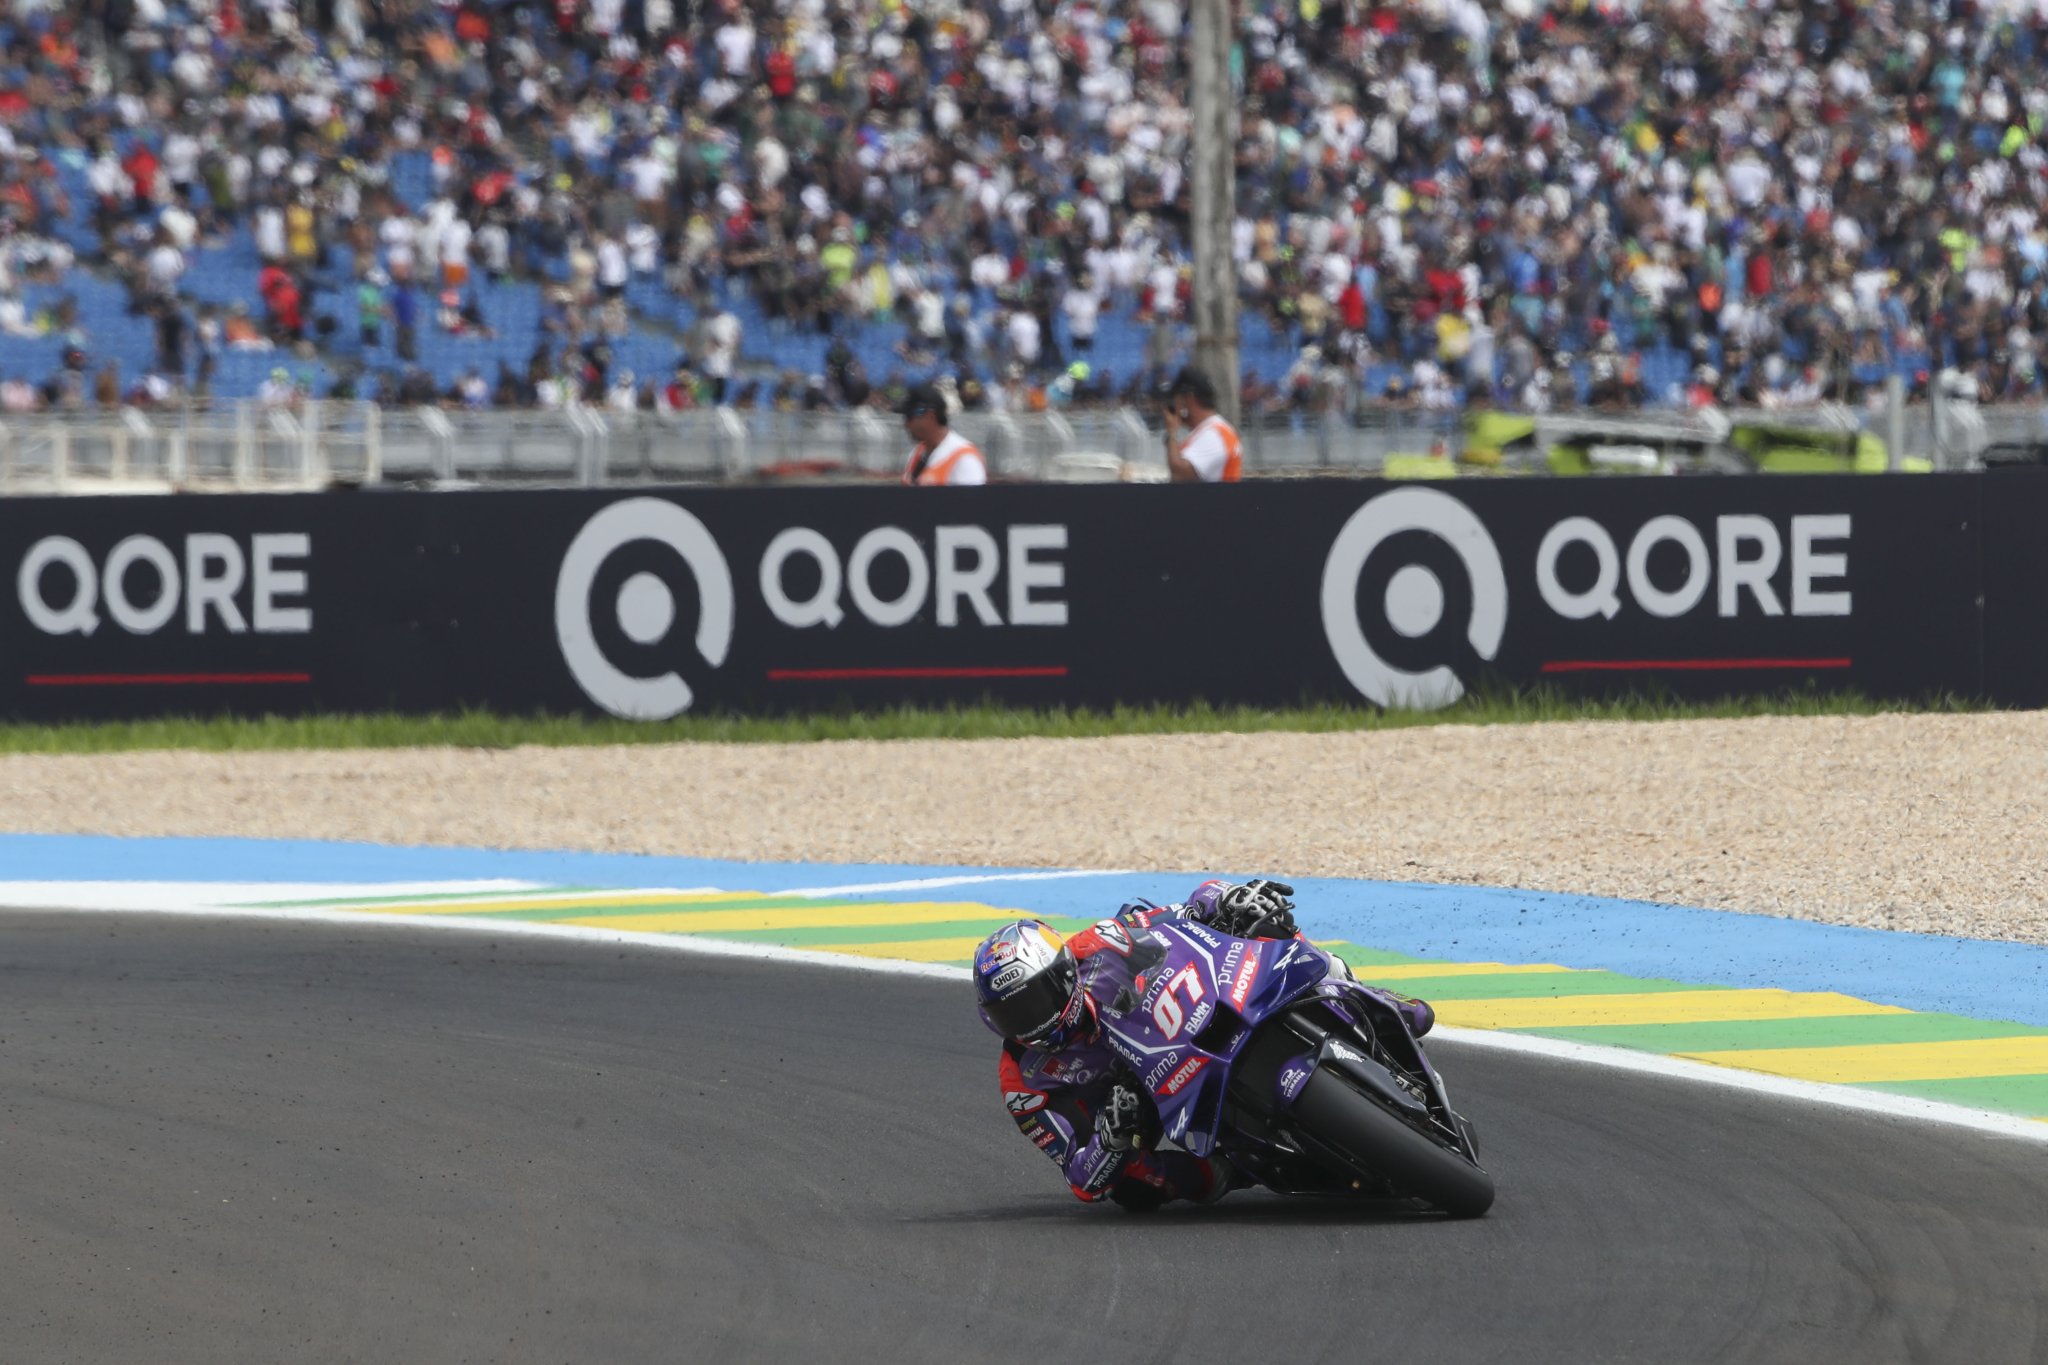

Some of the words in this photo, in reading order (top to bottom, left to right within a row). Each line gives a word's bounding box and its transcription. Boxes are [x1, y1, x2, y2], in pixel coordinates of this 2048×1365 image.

[19, 534, 312, 635] QORE
[760, 525, 1069, 628] QORE
[1537, 515, 1853, 620] QORE
[1182, 921, 1221, 949] PRAMAC
[993, 968, 1020, 989] SHOEI
[1218, 941, 1244, 985] prima
[1232, 956, 1257, 1003] MOTUL
[1141, 967, 1175, 1014] prima
[1153, 960, 1206, 1041] 07
[1184, 1001, 1212, 1035] FIAMM
[1108, 1036, 1143, 1067] PRAMAC
[1145, 1051, 1178, 1093] prima
[1167, 1058, 1202, 1094] MOTUL
[1093, 1152, 1123, 1187] PRAMAC
